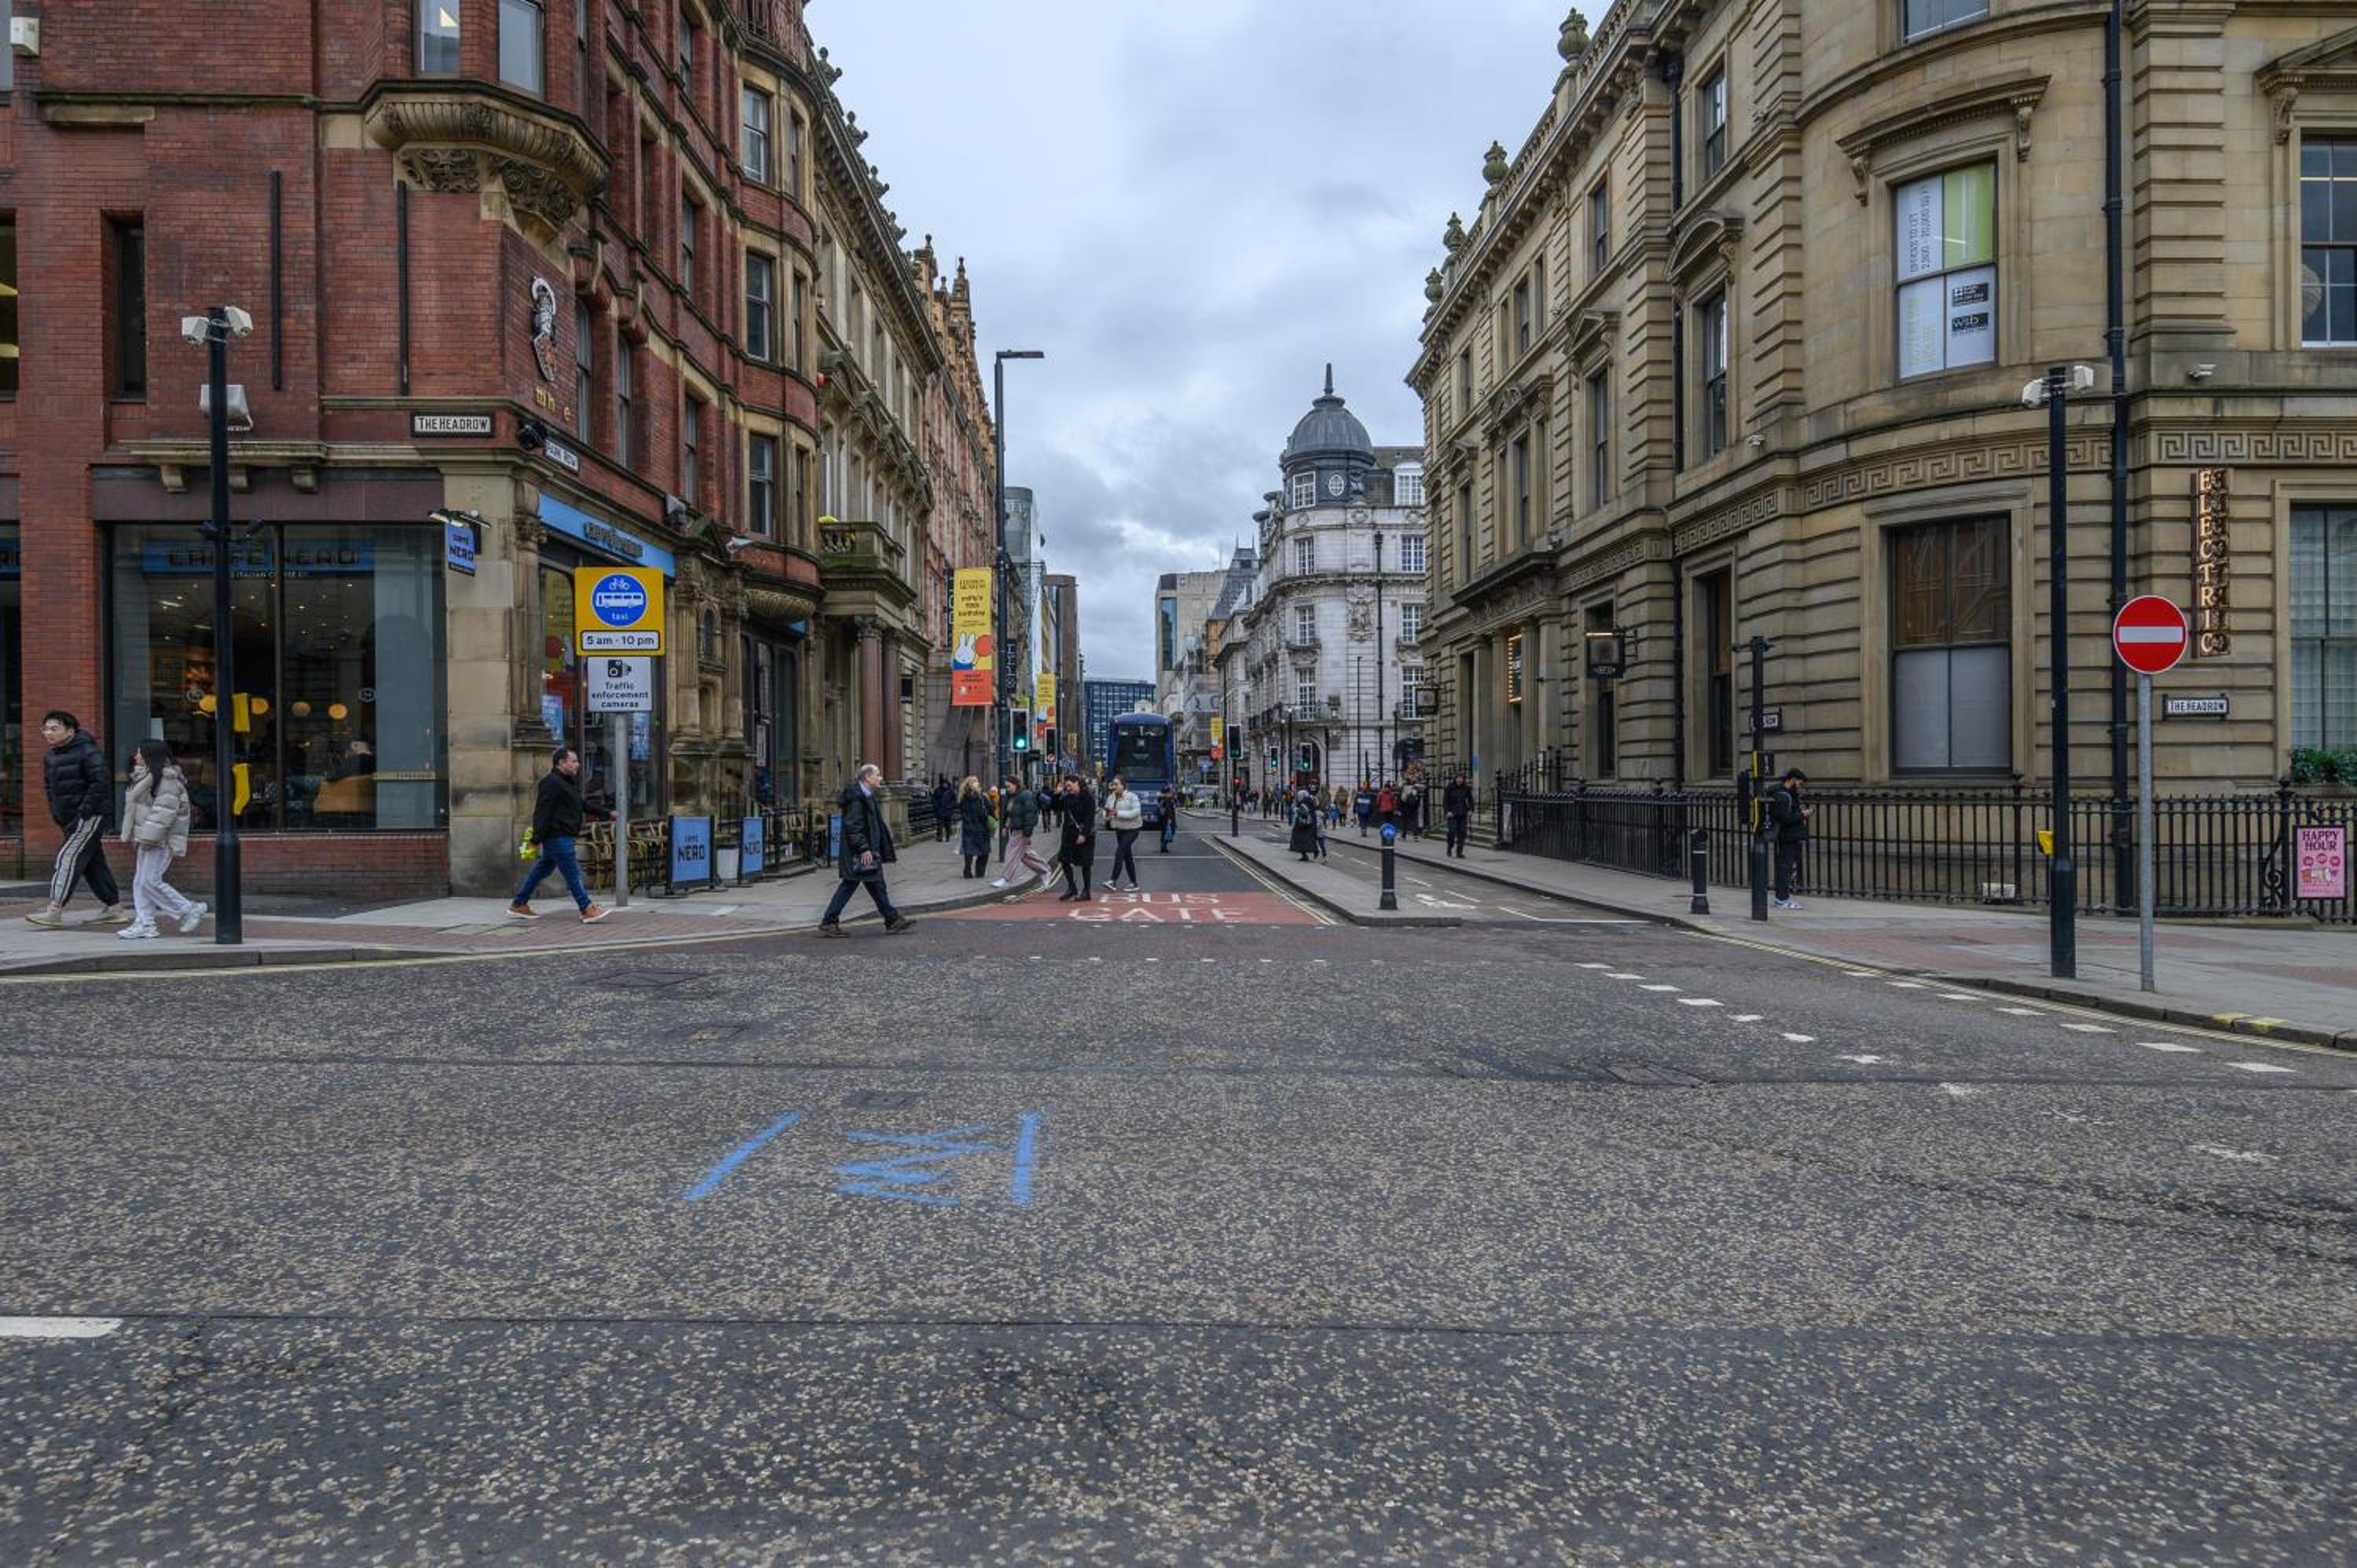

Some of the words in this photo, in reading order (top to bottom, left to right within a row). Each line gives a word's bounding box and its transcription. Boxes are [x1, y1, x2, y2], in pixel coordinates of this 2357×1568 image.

[418, 418, 437, 430] THE
[439, 418, 487, 430] HEADROW
[449, 546, 474, 561] NERO
[2198, 471, 2213, 653] ELECTRIC
[587, 636, 594, 645] 5
[621, 636, 635, 645] 10
[605, 682, 634, 691] Traffic
[2170, 701, 2186, 711] THE
[2187, 701, 2225, 711] HEADROW
[2303, 830, 2339, 841] HAPPY
[2304, 841, 2337, 852] HOUR
[678, 844, 705, 862] NERO
[1068, 907, 1249, 922] GATE
